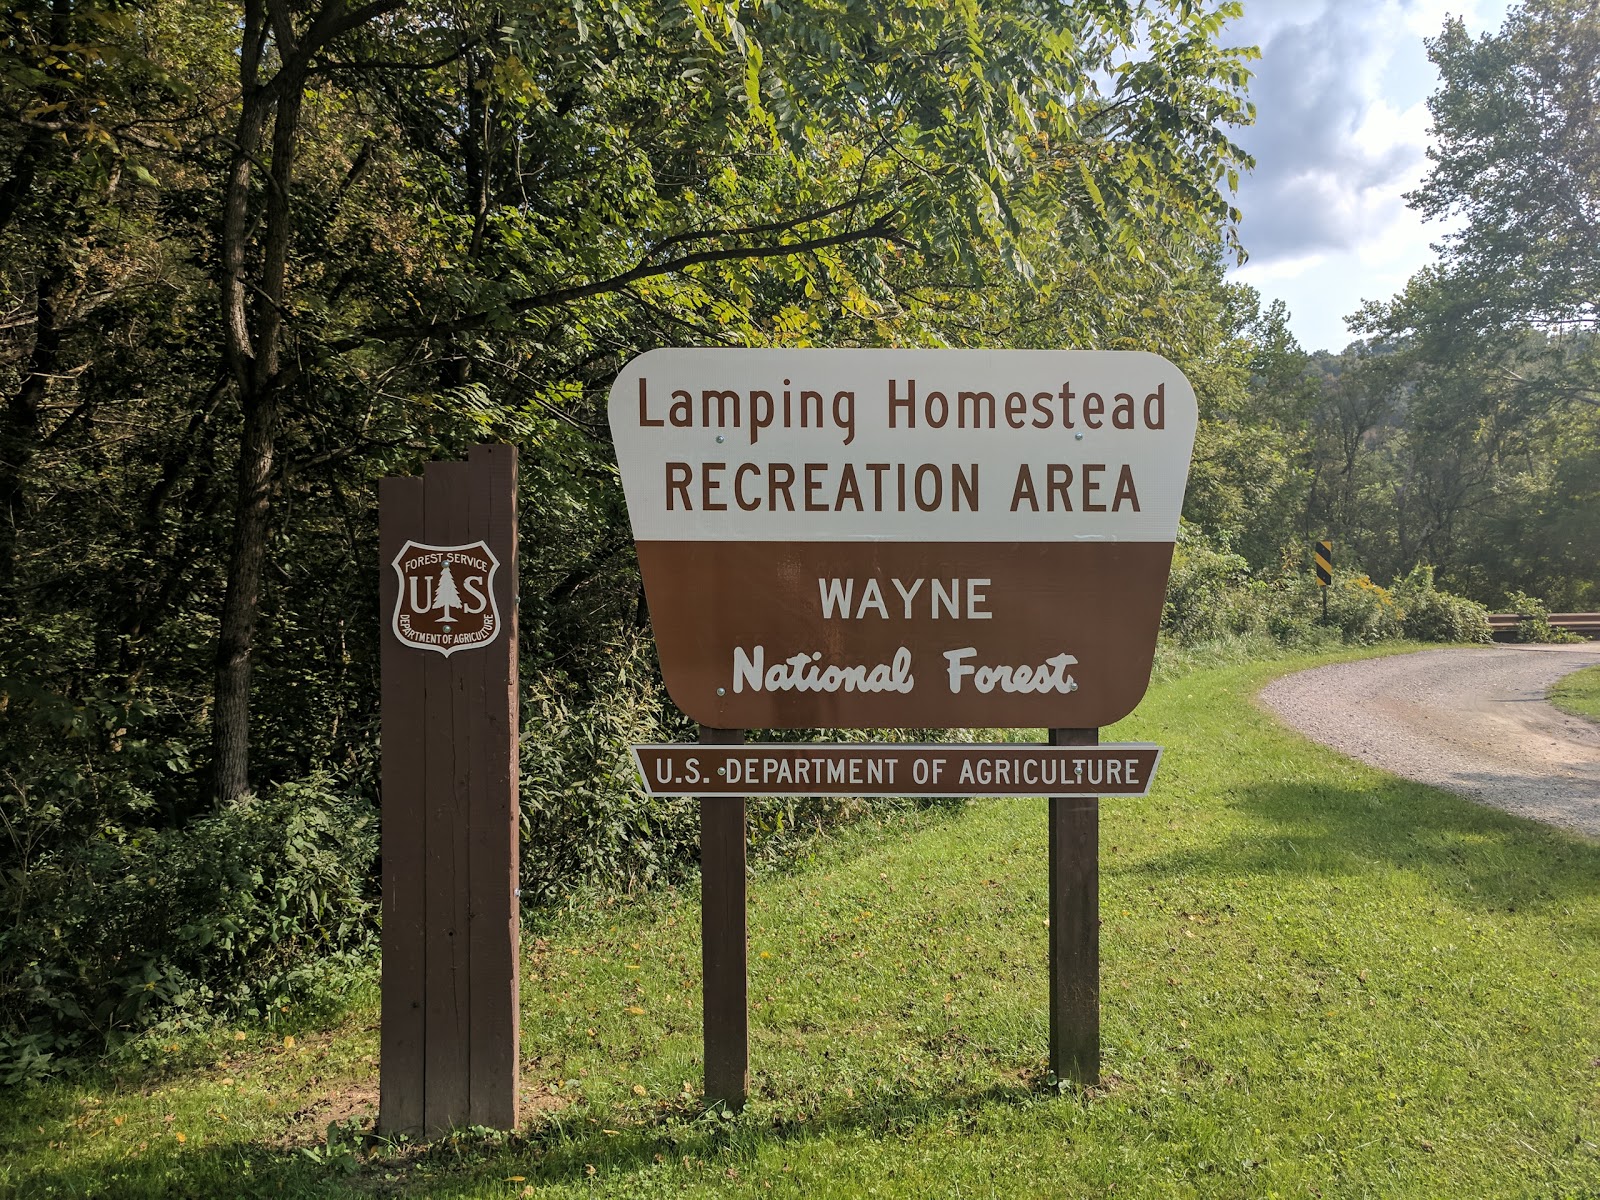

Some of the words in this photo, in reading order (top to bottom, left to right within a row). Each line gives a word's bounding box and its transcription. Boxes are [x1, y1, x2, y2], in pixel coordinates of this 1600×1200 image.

[638, 377, 856, 446] Lamping
[888, 378, 1166, 431] Homestead
[664, 461, 979, 512] RECREATION
[1009, 462, 1141, 513] AREA
[405, 552, 443, 573] FOREST
[446, 552, 488, 573] SERVICE
[409, 576, 434, 614] U
[463, 576, 487, 614] S
[818, 577, 992, 620] WAYNE
[400, 614, 442, 644] DEPARTMENT
[442, 634, 453, 644] OF
[453, 614, 493, 644] AGRICULTURE
[732, 645, 914, 694] National
[942, 646, 1078, 694] Forest
[656, 757, 710, 785] U.S.
[726, 757, 898, 785] DEPARTMENT
[912, 758, 947, 785] OF
[958, 758, 1140, 785] AGRICULTURE
